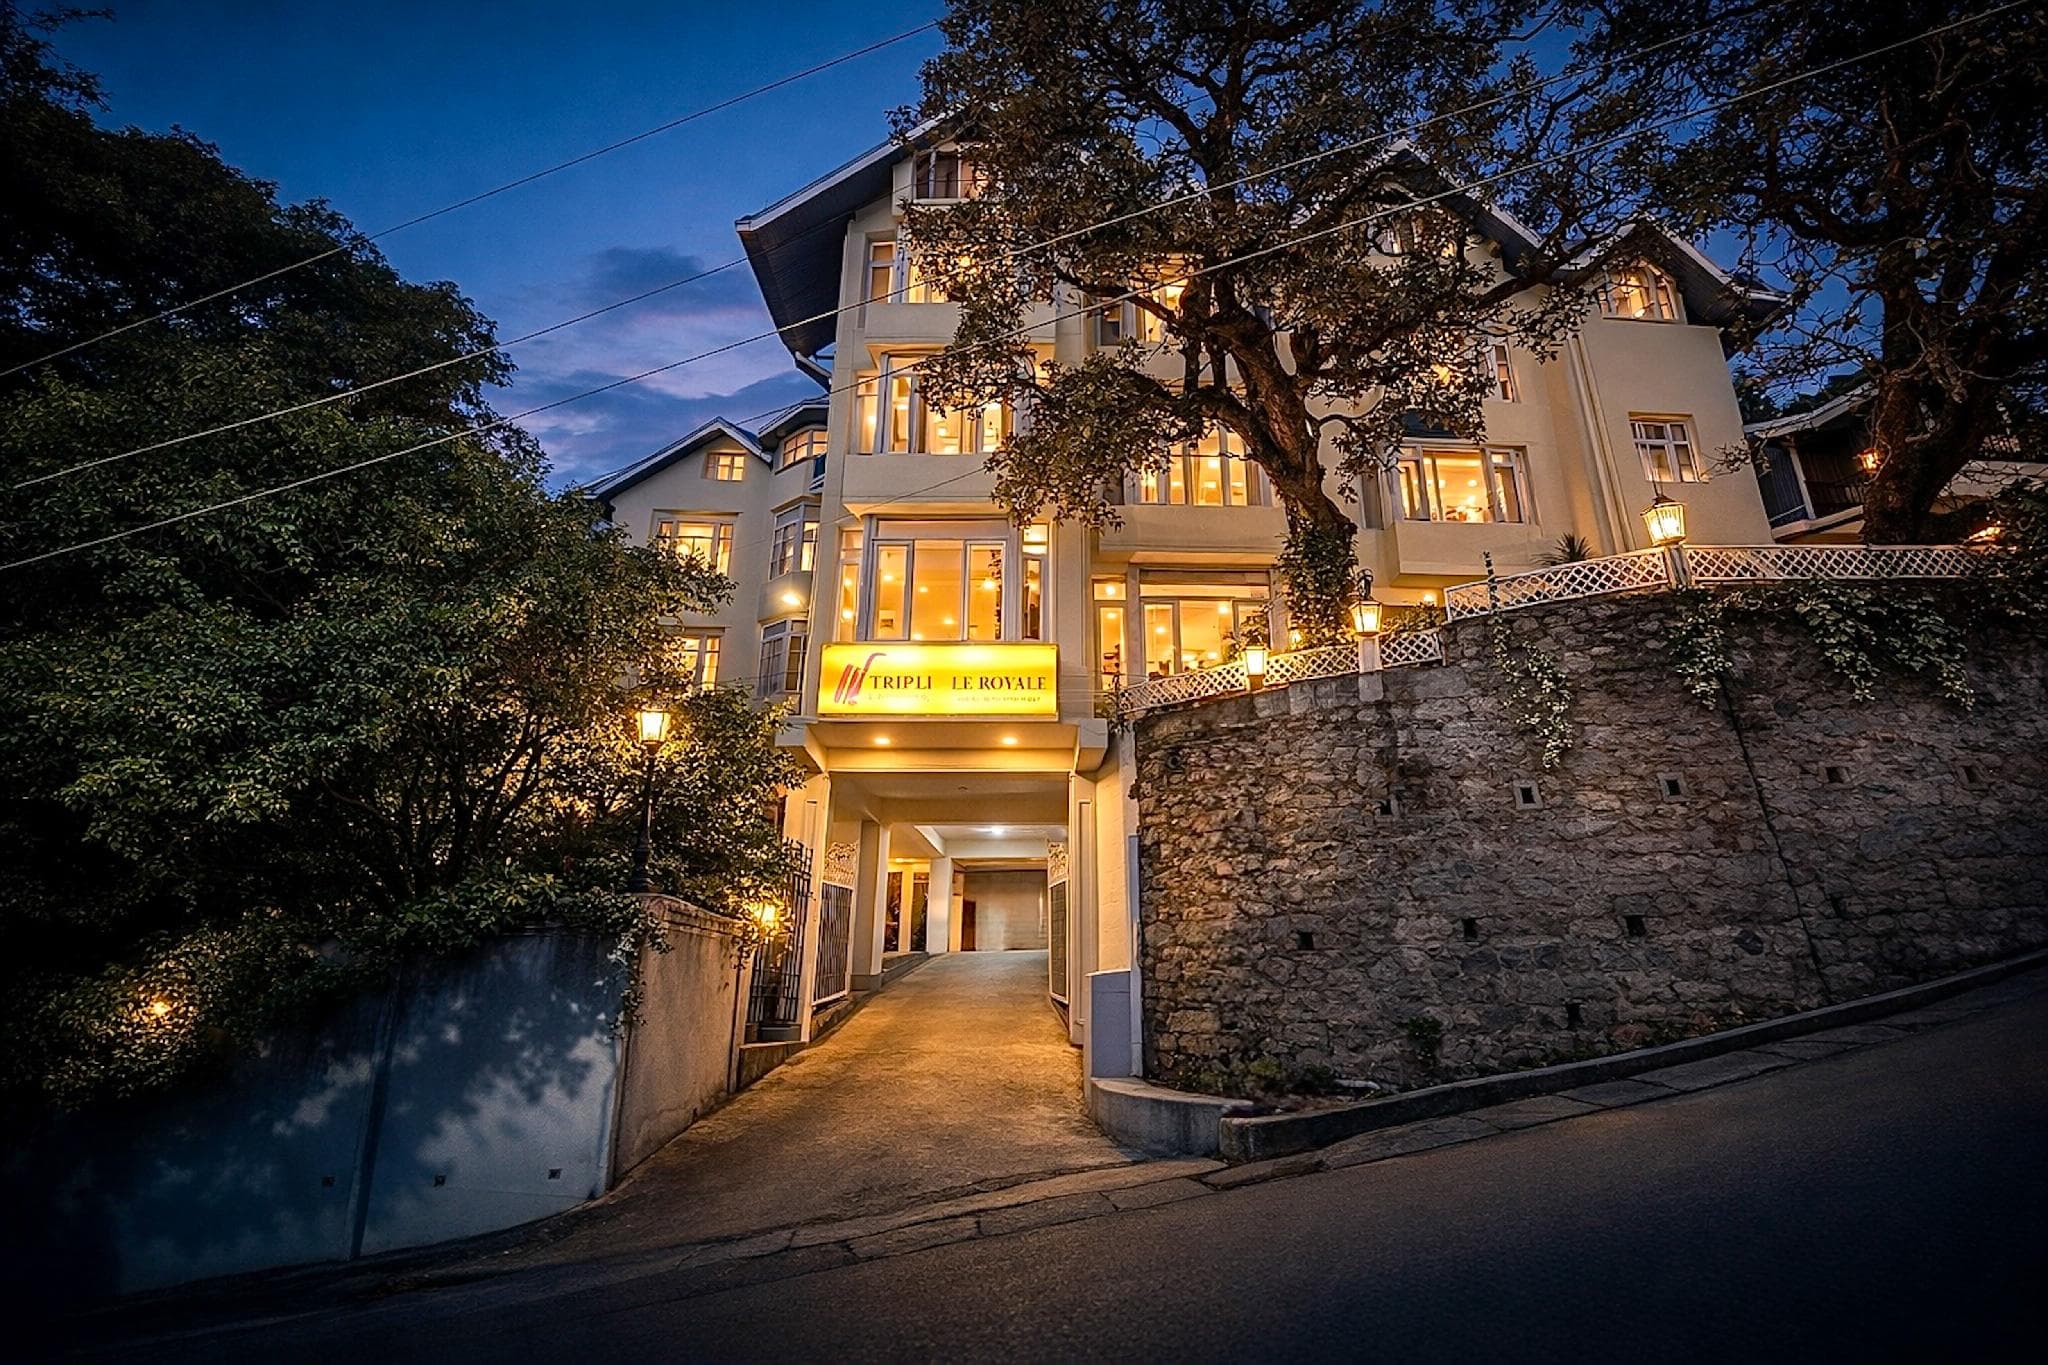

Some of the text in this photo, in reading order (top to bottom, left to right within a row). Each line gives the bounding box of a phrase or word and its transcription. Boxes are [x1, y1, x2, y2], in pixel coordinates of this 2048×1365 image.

[869, 675, 1047, 690] TRIPLI LE ROYALE
